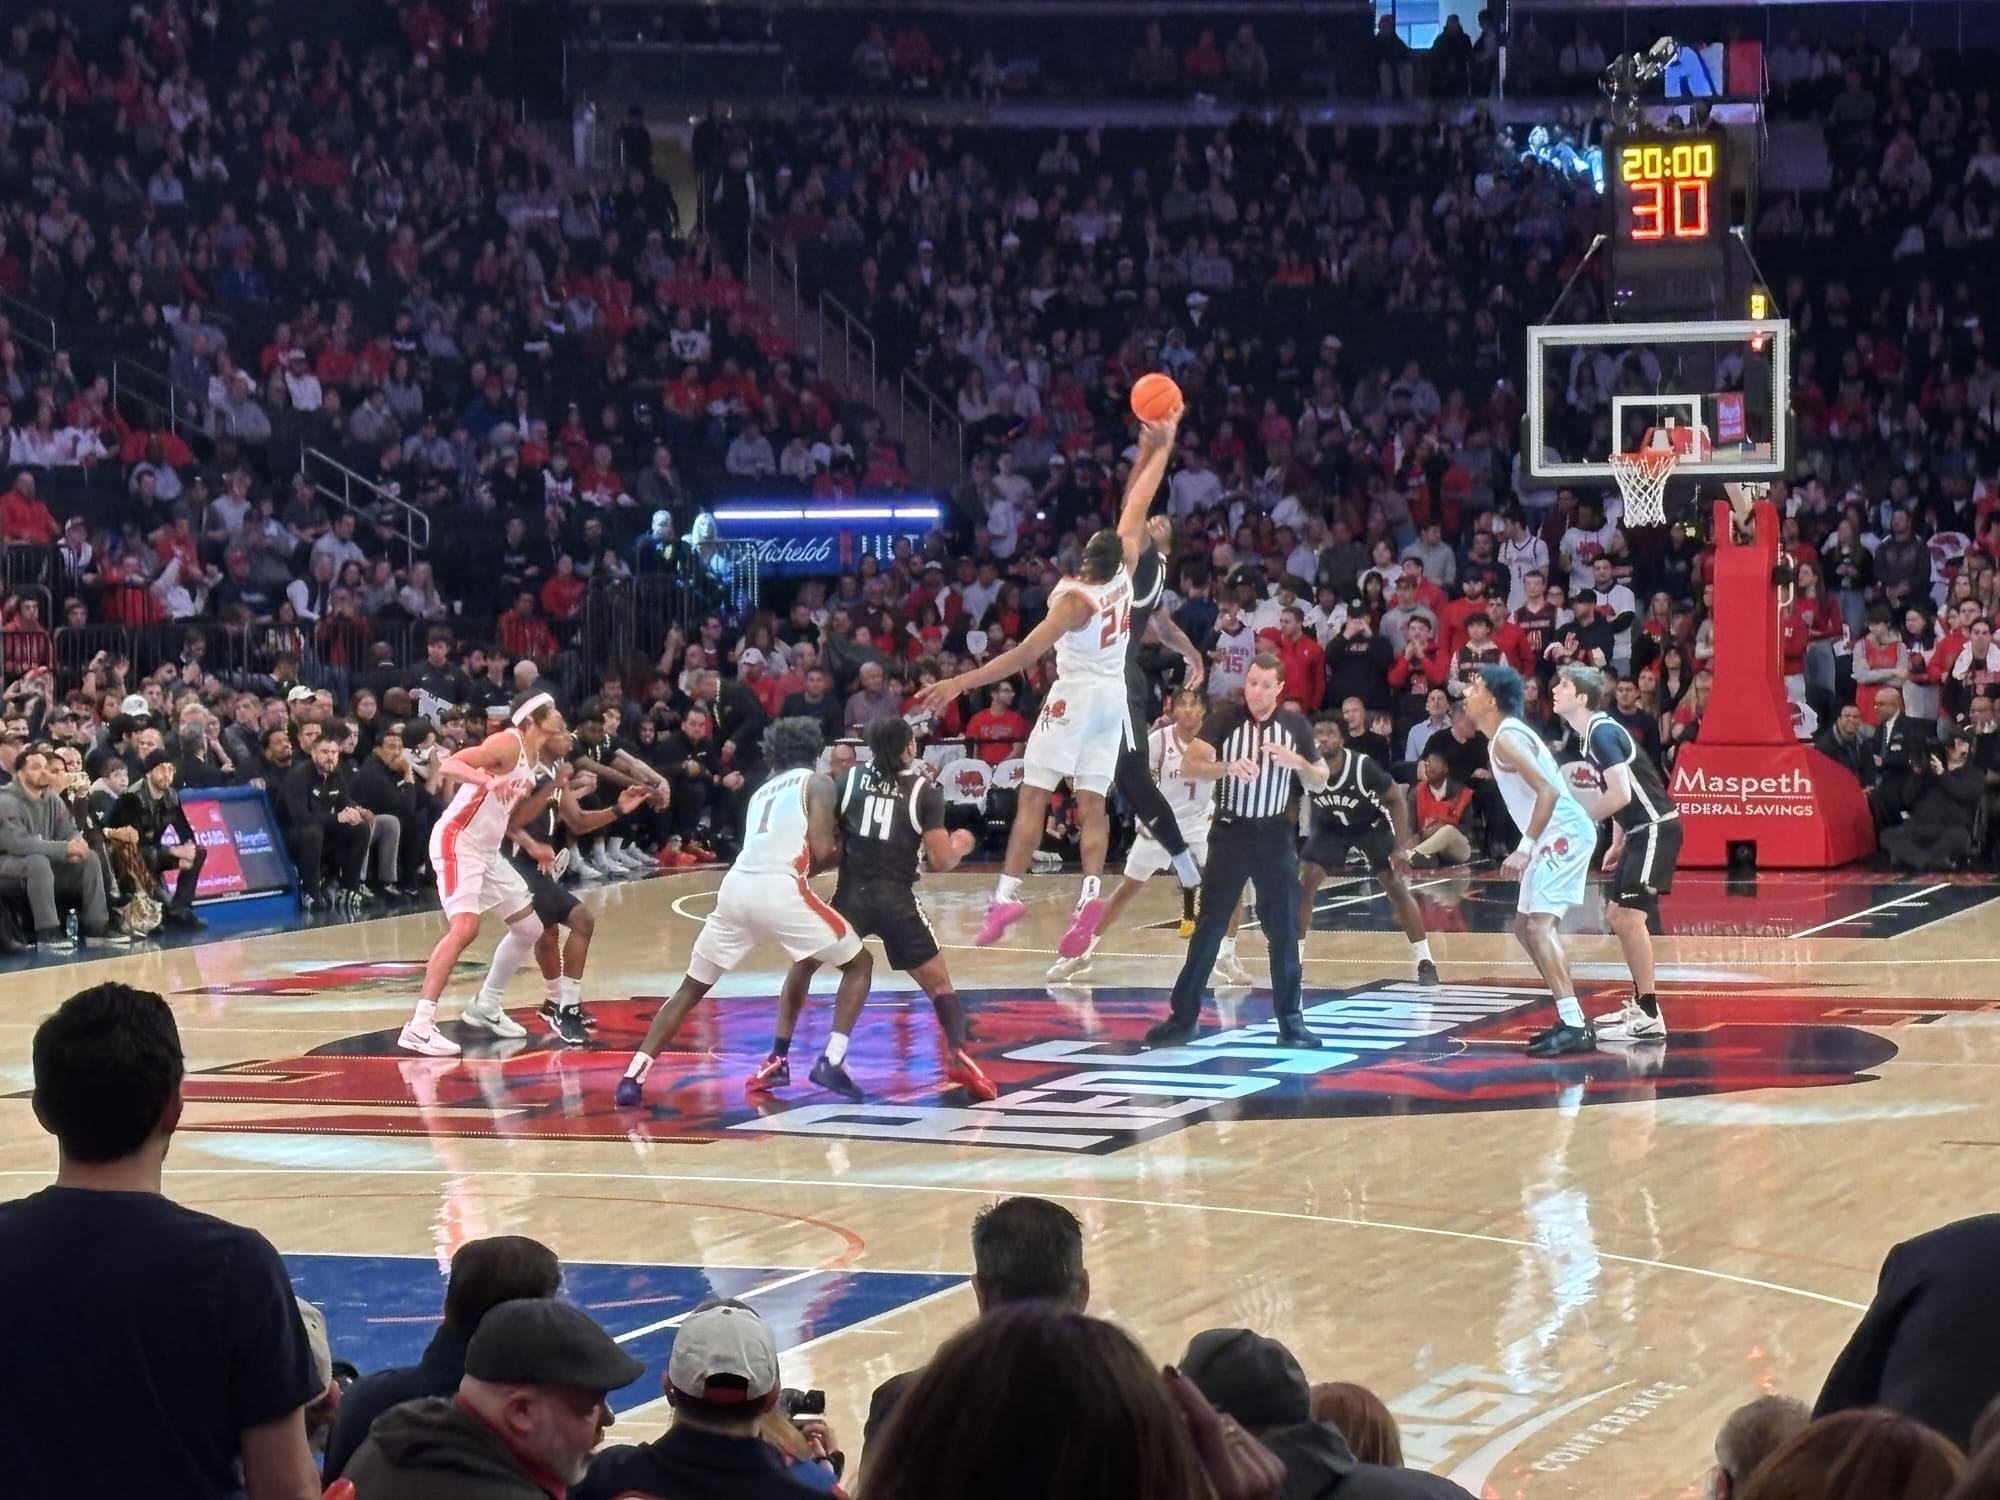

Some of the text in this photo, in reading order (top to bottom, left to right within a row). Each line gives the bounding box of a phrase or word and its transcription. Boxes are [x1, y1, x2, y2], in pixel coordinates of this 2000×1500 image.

[1622, 144, 1714, 182] 20:00
[1630, 180, 1708, 240] 30
[1223, 655, 1244, 674] 15
[1673, 766, 1812, 801] Maspeth
[859, 795, 895, 840] 14
[1675, 802, 1814, 817] FEDERAL SAVINGS
